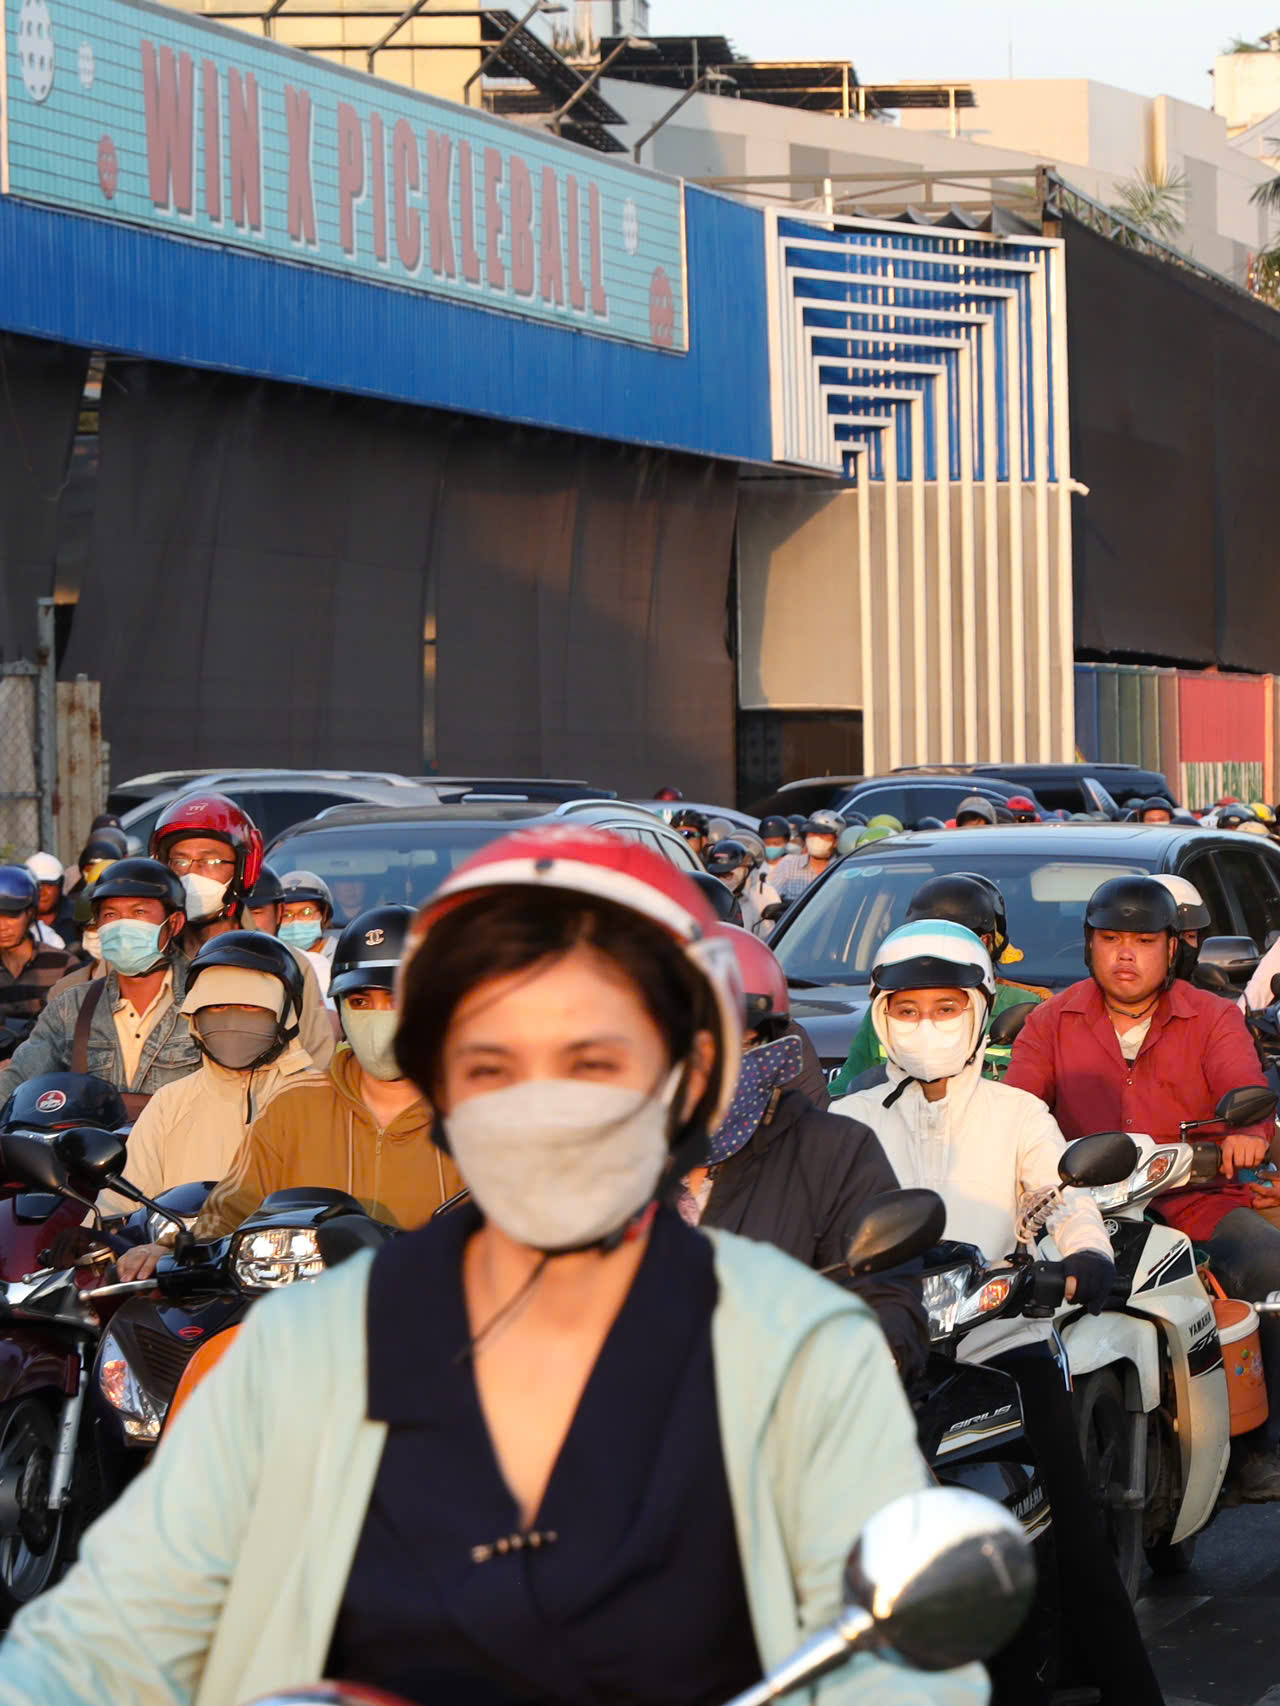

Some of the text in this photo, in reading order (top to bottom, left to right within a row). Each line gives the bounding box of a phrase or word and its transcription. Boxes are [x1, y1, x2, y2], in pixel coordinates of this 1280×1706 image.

[141, 39, 608, 318] WIN X PICKLEBALL
[1188, 1312, 1212, 1338] YAMAHA
[1011, 1485, 1044, 1519] YAMAHA
